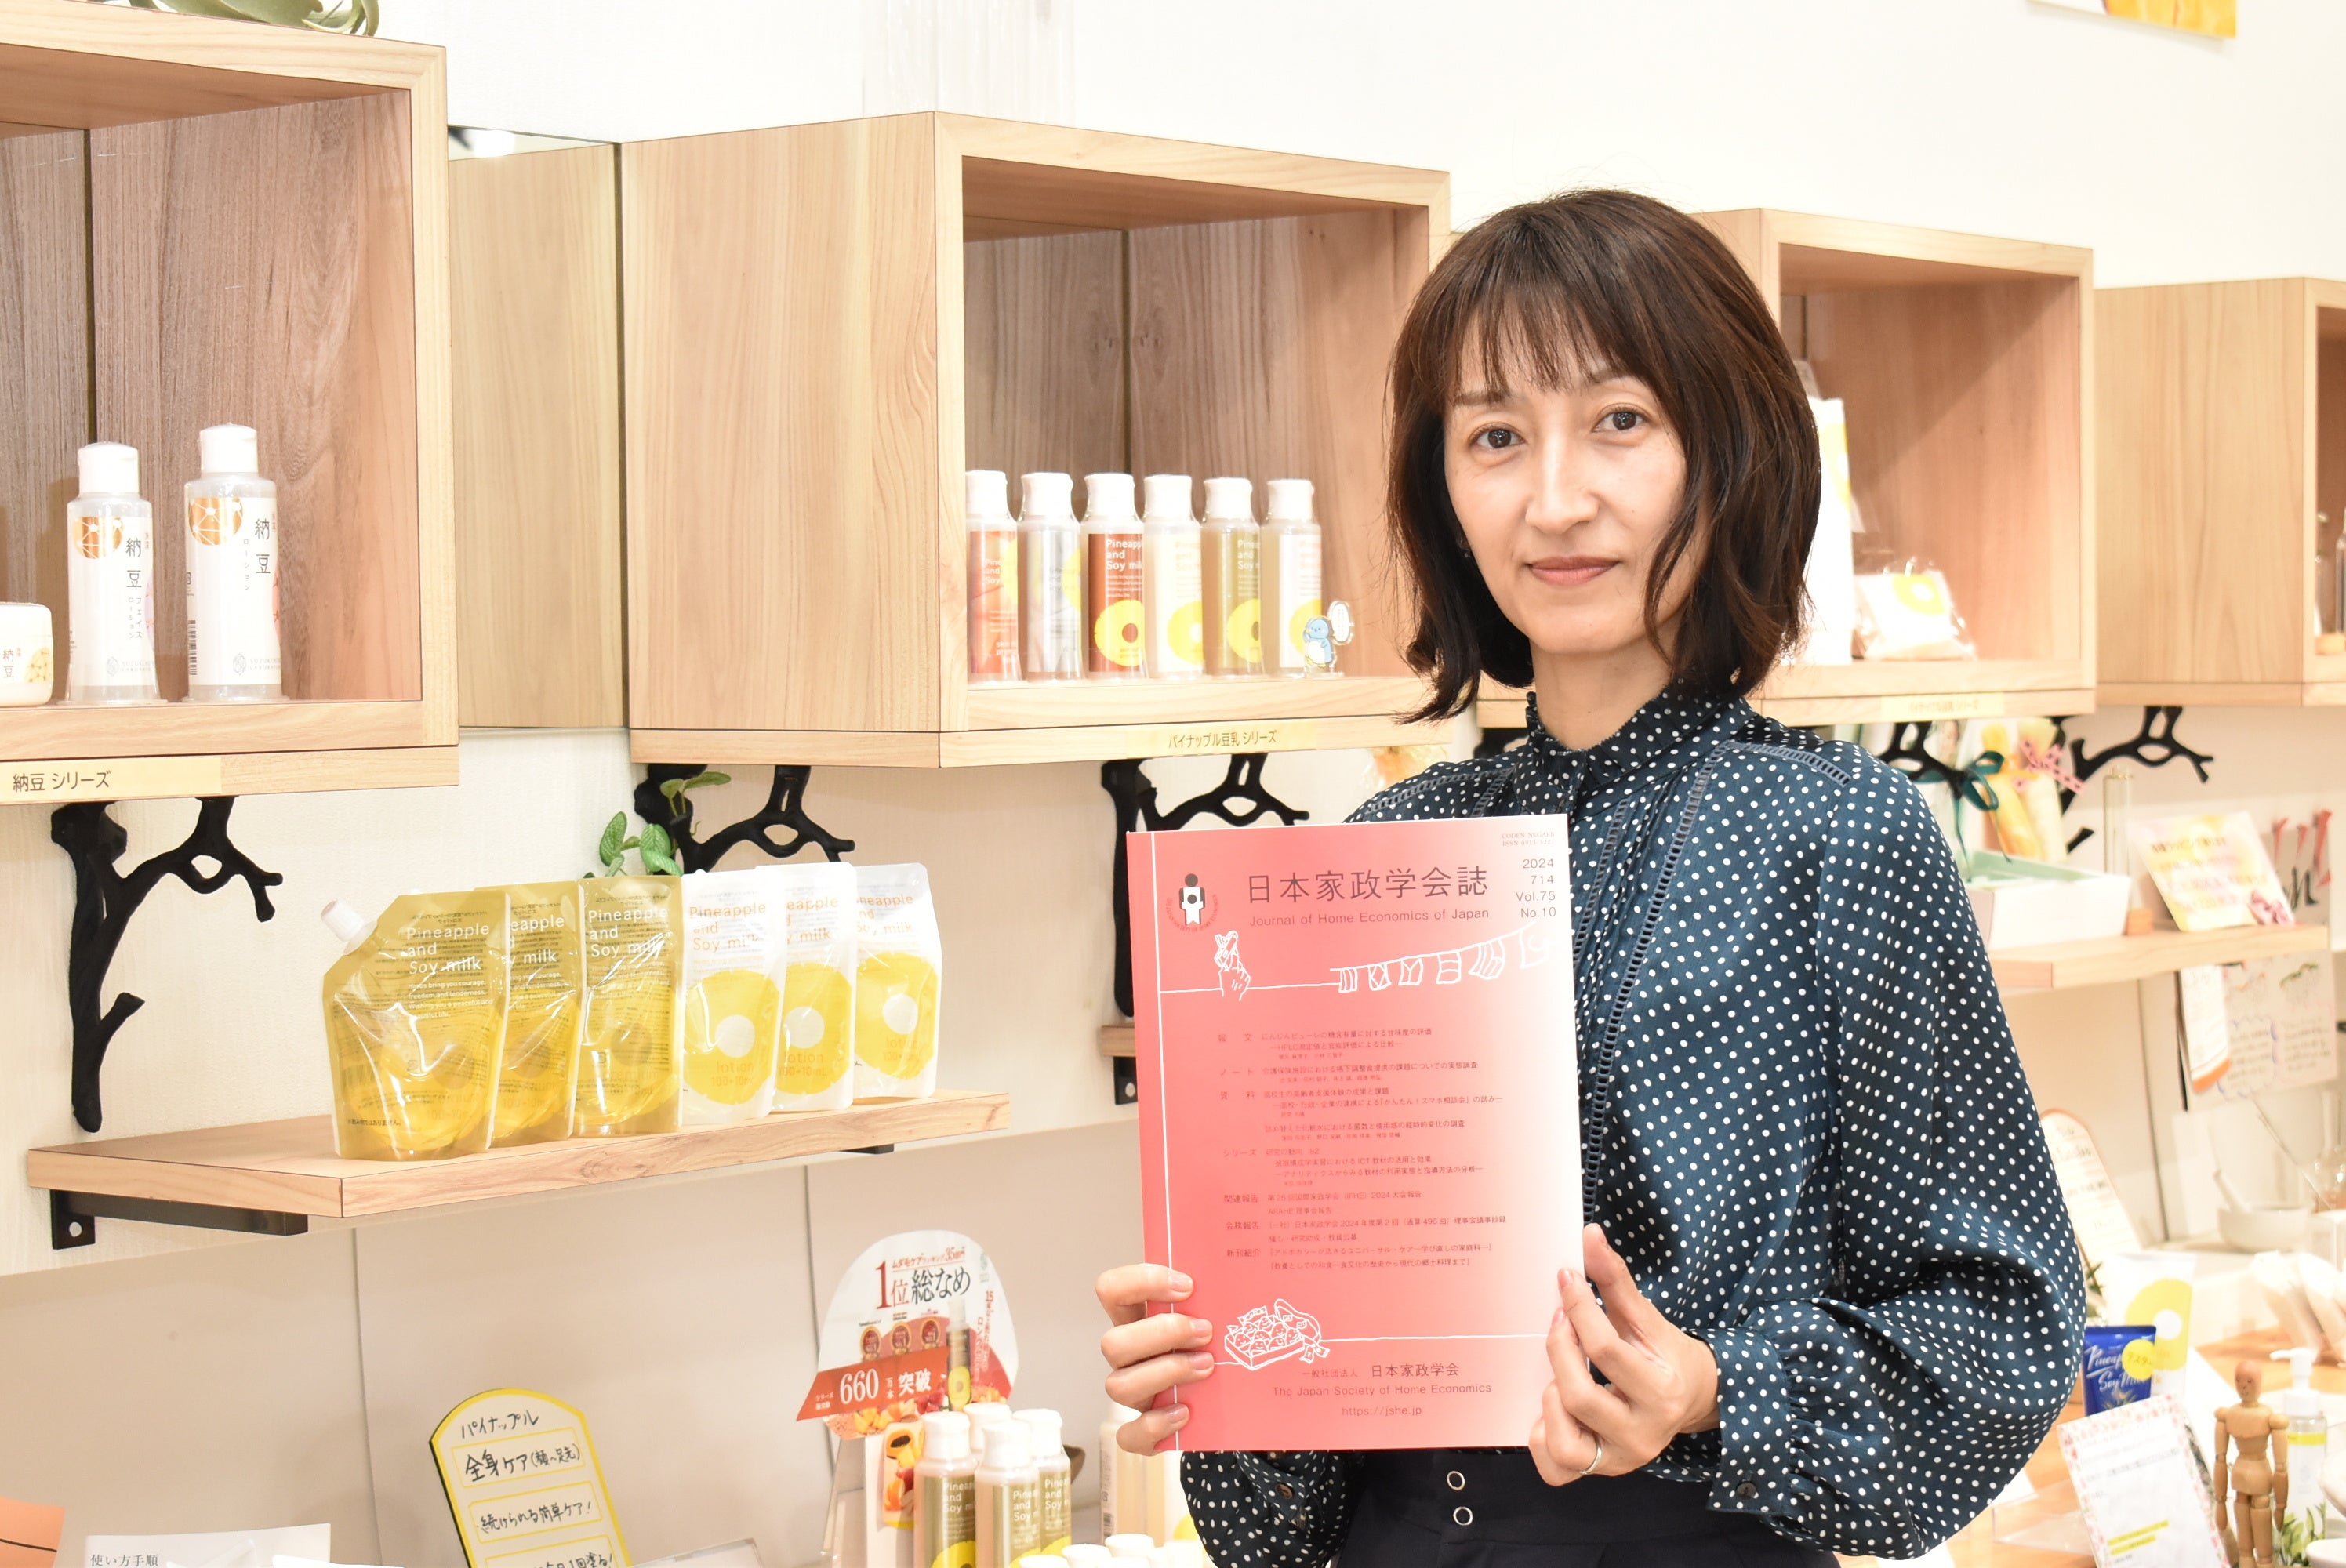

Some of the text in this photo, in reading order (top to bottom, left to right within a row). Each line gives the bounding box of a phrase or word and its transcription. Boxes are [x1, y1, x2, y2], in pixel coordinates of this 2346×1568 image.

[255, 518, 271, 574] 納豆
[1106, 550, 1126, 559] and
[125, 538, 142, 588] 納豆
[1106, 561, 1126, 572] Soy
[1237, 561, 1254, 571] Soy
[3, 649, 14, 678] 納豆
[1168, 730, 1277, 749] パイナップル豆乳 シリーズ
[13, 770, 111, 793] 納豆 シリーズ
[1523, 858, 1554, 869] 2024
[1247, 866, 1489, 904] 日本家政学会誌
[1531, 875, 1554, 884] 714
[1516, 891, 1556, 902] Vol.75
[588, 907, 669, 924] Pineapple
[689, 902, 766, 918] Pineapple
[1249, 907, 1490, 927] Journal of Home Economics of Japan
[1521, 906, 1556, 918] No.10
[408, 923, 490, 940] Pineapple
[590, 925, 619, 940] and
[800, 928, 832, 942] milk
[408, 942, 438, 957] and
[590, 944, 619, 958] Soy
[693, 938, 720, 953] Soy
[523, 948, 557, 964] milk
[409, 956, 481, 975] Soy milk
[784, 1051, 824, 1064] lotion
[717, 1061, 754, 1073] lotion
[1223, 1149, 1257, 1157] シリーズ
[1224, 1194, 1258, 1203] 関連報告
[1225, 1221, 1260, 1230] 会務報告
[1226, 1248, 1261, 1258] 新刊紹介
[1302, 1363, 1460, 1378] 一般社団法人 日本家政学会
[1273, 1383, 1492, 1397] The Japan Society of Home Economics
[1342, 1406, 1422, 1417] https://jshe.jp
[461, 1410, 539, 1439] パイナップル
[1045, 1490, 1062, 1498] and
[943, 1503, 962, 1514] Soy
[1013, 1500, 1031, 1510] and
[1045, 1500, 1062, 1512] Soy
[1013, 1512, 1032, 1523] Soy
[90, 1553, 158, 1567] 使い方手順
